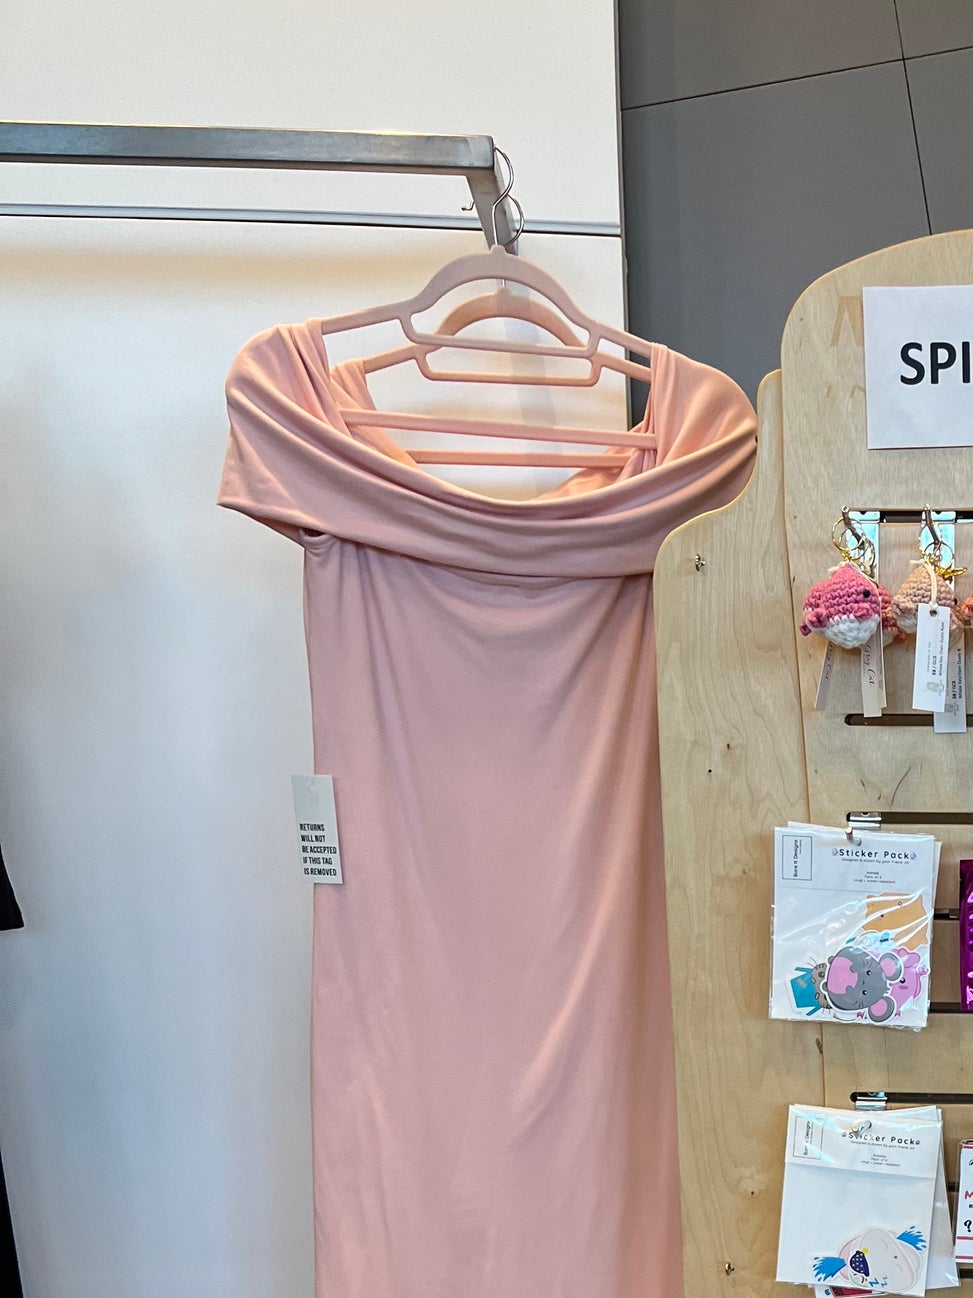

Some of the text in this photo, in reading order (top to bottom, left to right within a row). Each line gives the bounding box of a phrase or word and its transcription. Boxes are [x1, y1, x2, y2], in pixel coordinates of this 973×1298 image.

[299, 823, 325, 832] RETURNS
[301, 834, 326, 843] WILL NOT
[301, 845, 337, 855] BE ACCEPTED
[839, 848, 909, 860] Sticker Pack
[309, 857, 321, 865] THIS
[322, 857, 333, 865] TAG
[304, 867, 337, 876] IS REMOVED
[890, 1135, 915, 1145] Pack
